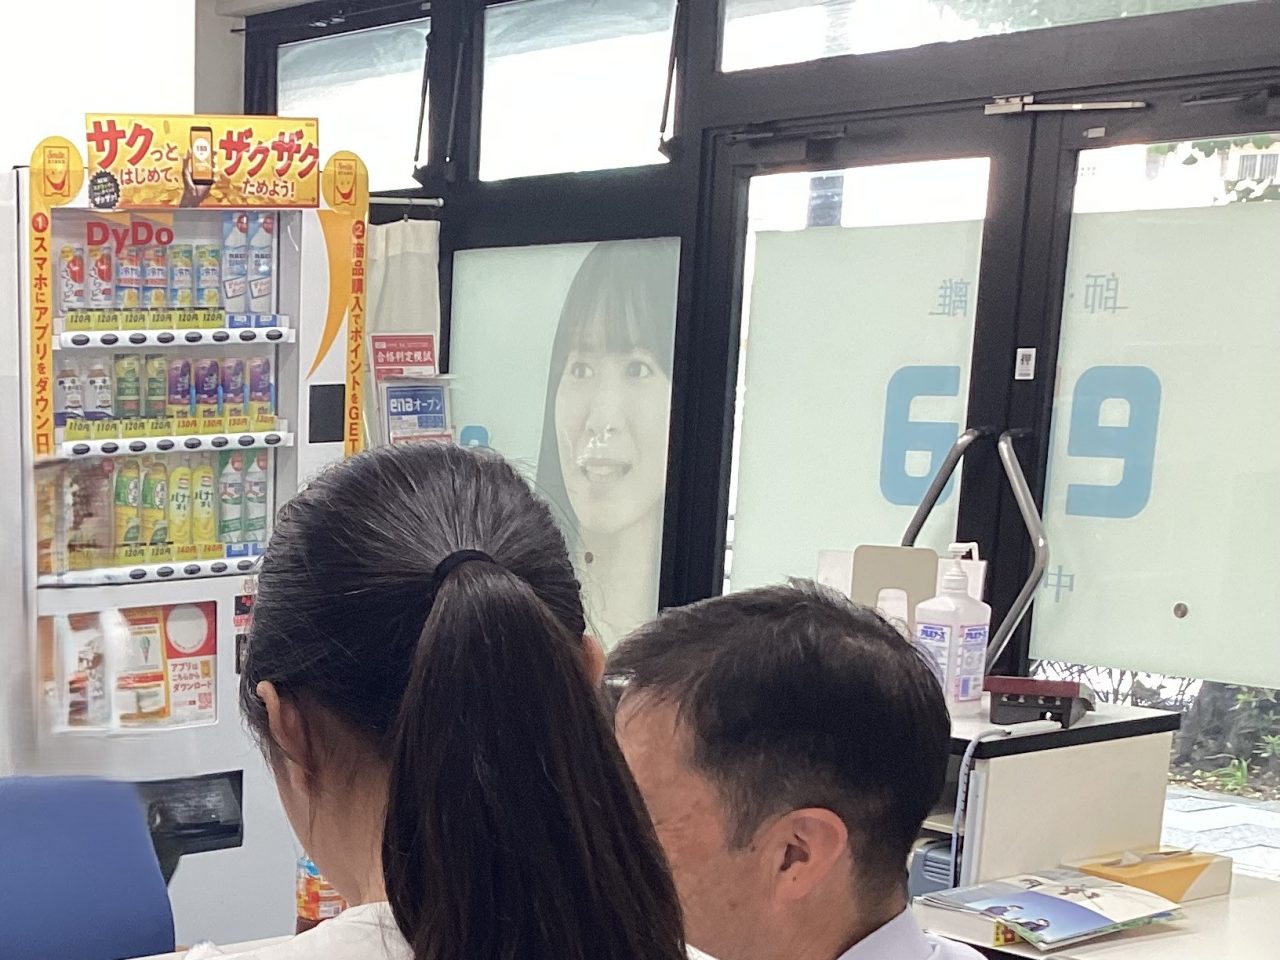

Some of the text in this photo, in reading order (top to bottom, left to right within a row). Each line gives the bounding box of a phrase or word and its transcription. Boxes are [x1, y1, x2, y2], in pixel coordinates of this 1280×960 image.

[86, 119, 179, 170] サクっと
[219, 127, 319, 179] ザクザク
[86, 221, 174, 257] DyDo
[172, 681, 212, 693] ダウンロード
